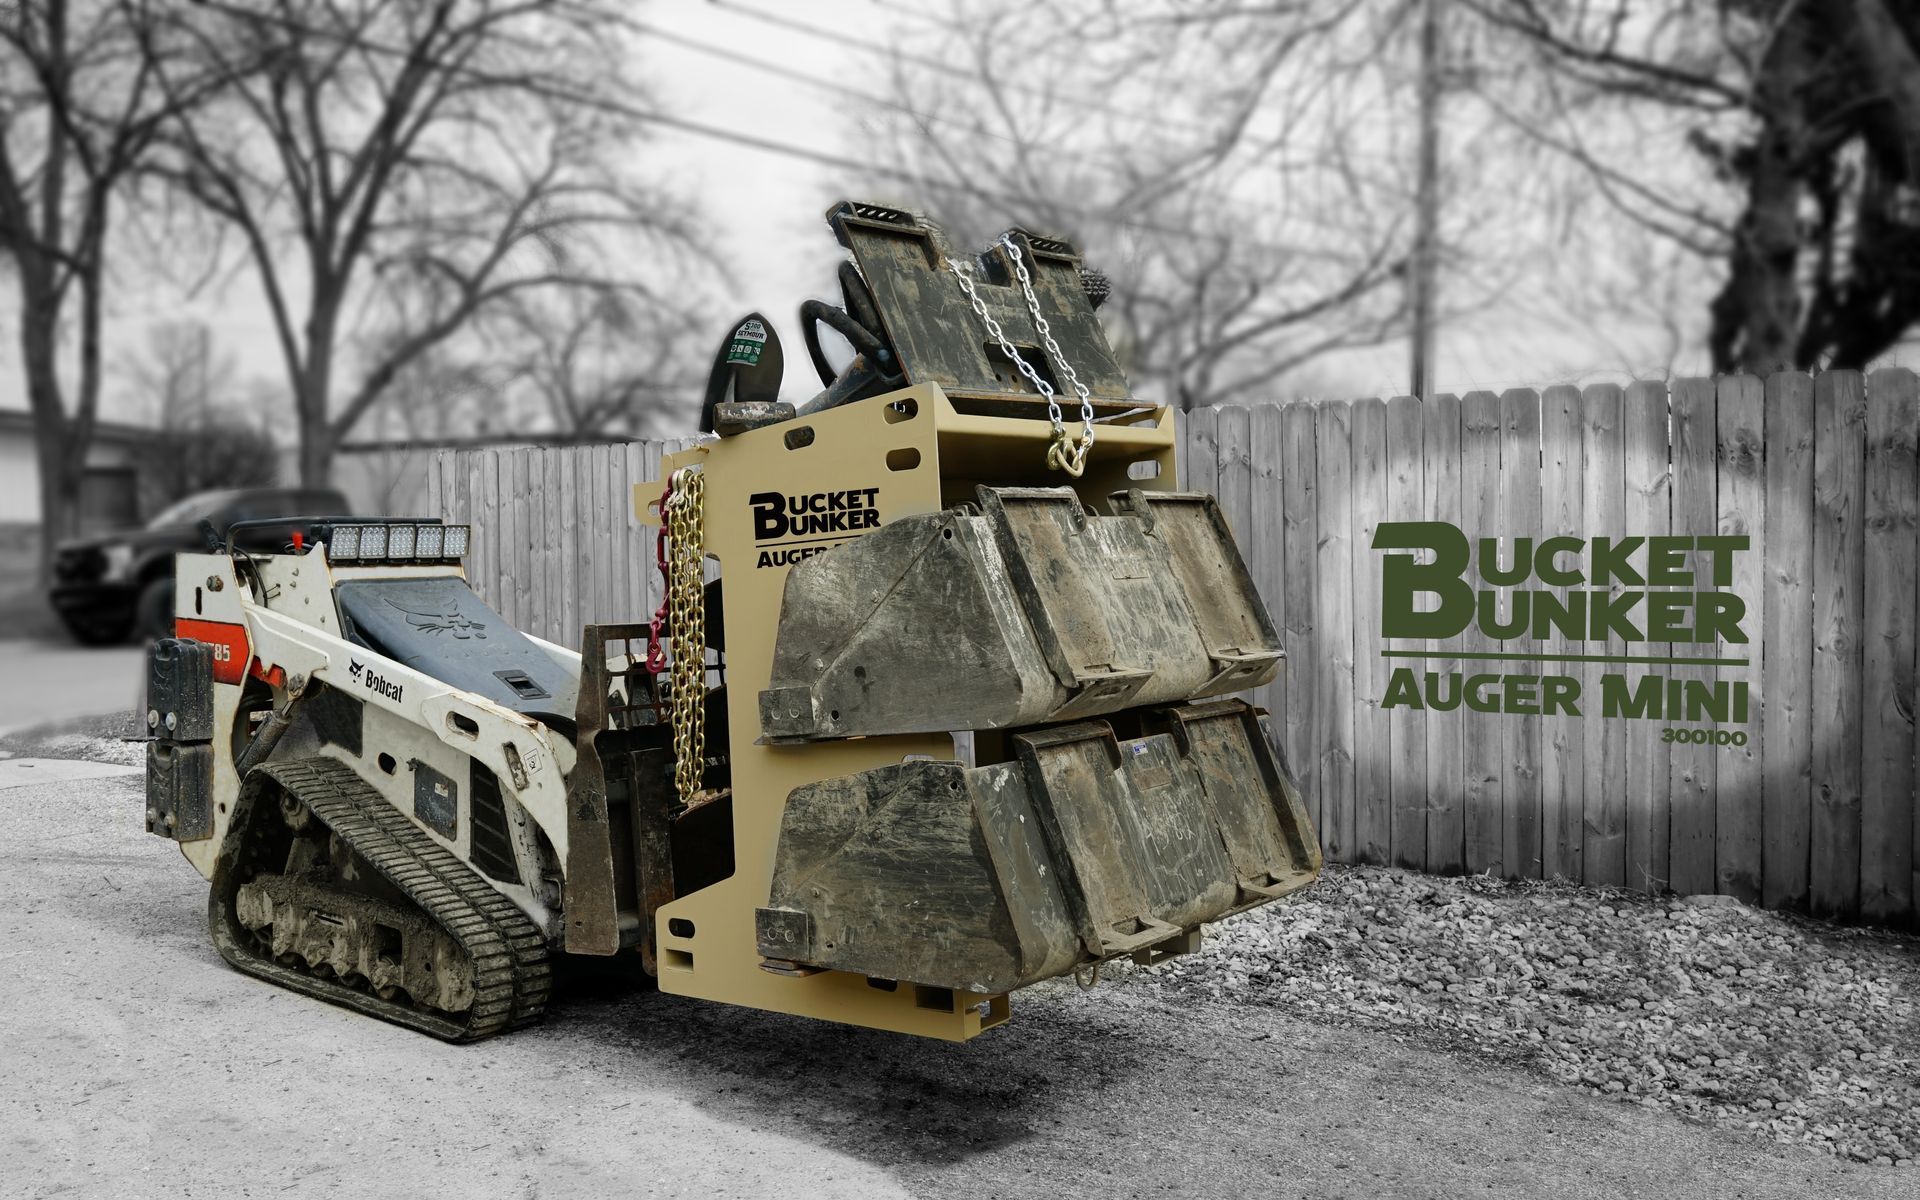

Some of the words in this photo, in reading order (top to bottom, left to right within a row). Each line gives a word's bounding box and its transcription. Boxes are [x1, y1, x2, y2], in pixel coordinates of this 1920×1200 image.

[737, 330, 764, 339] SEYMOUR
[749, 488, 879, 515] BUCKET
[754, 509, 881, 540] BUNKER
[202, 642, 230, 661] 85
[365, 669, 403, 703] Bobcat
